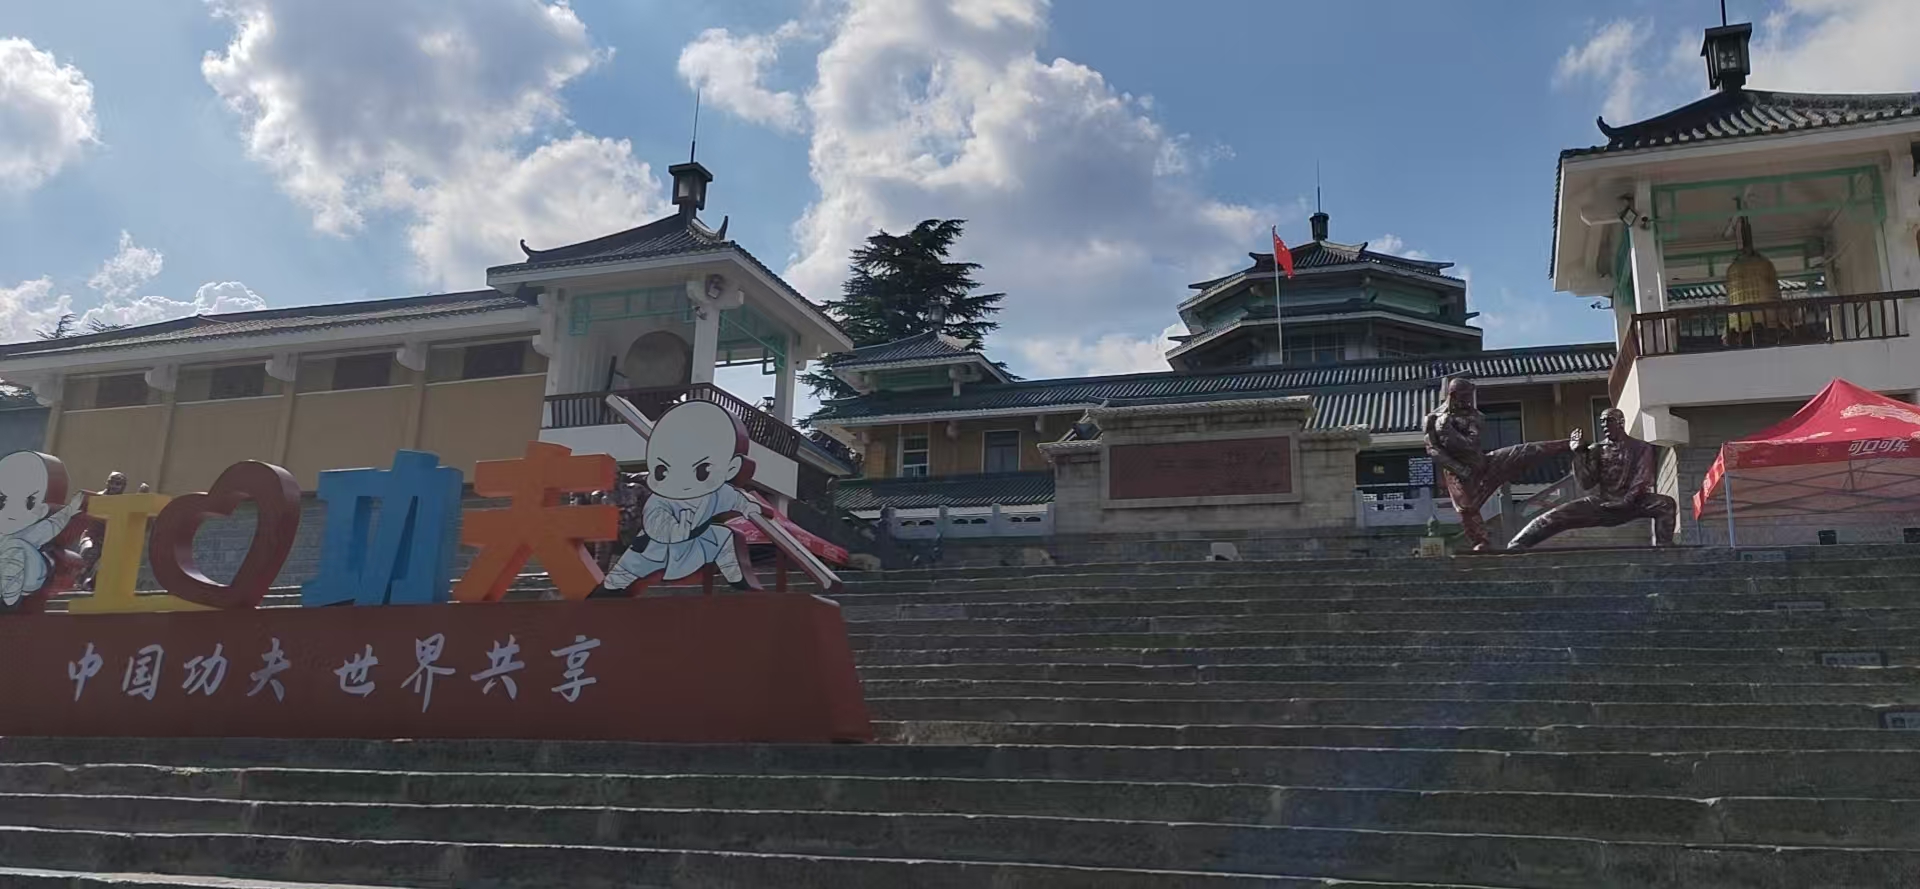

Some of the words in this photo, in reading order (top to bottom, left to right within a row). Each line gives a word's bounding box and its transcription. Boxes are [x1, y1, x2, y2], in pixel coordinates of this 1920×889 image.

[1848, 439, 1910, 456] 可口可乐
[302, 440, 620, 607] 功夫
[68, 642, 291, 702] 中国功夫
[333, 633, 601, 713] 世界共享
